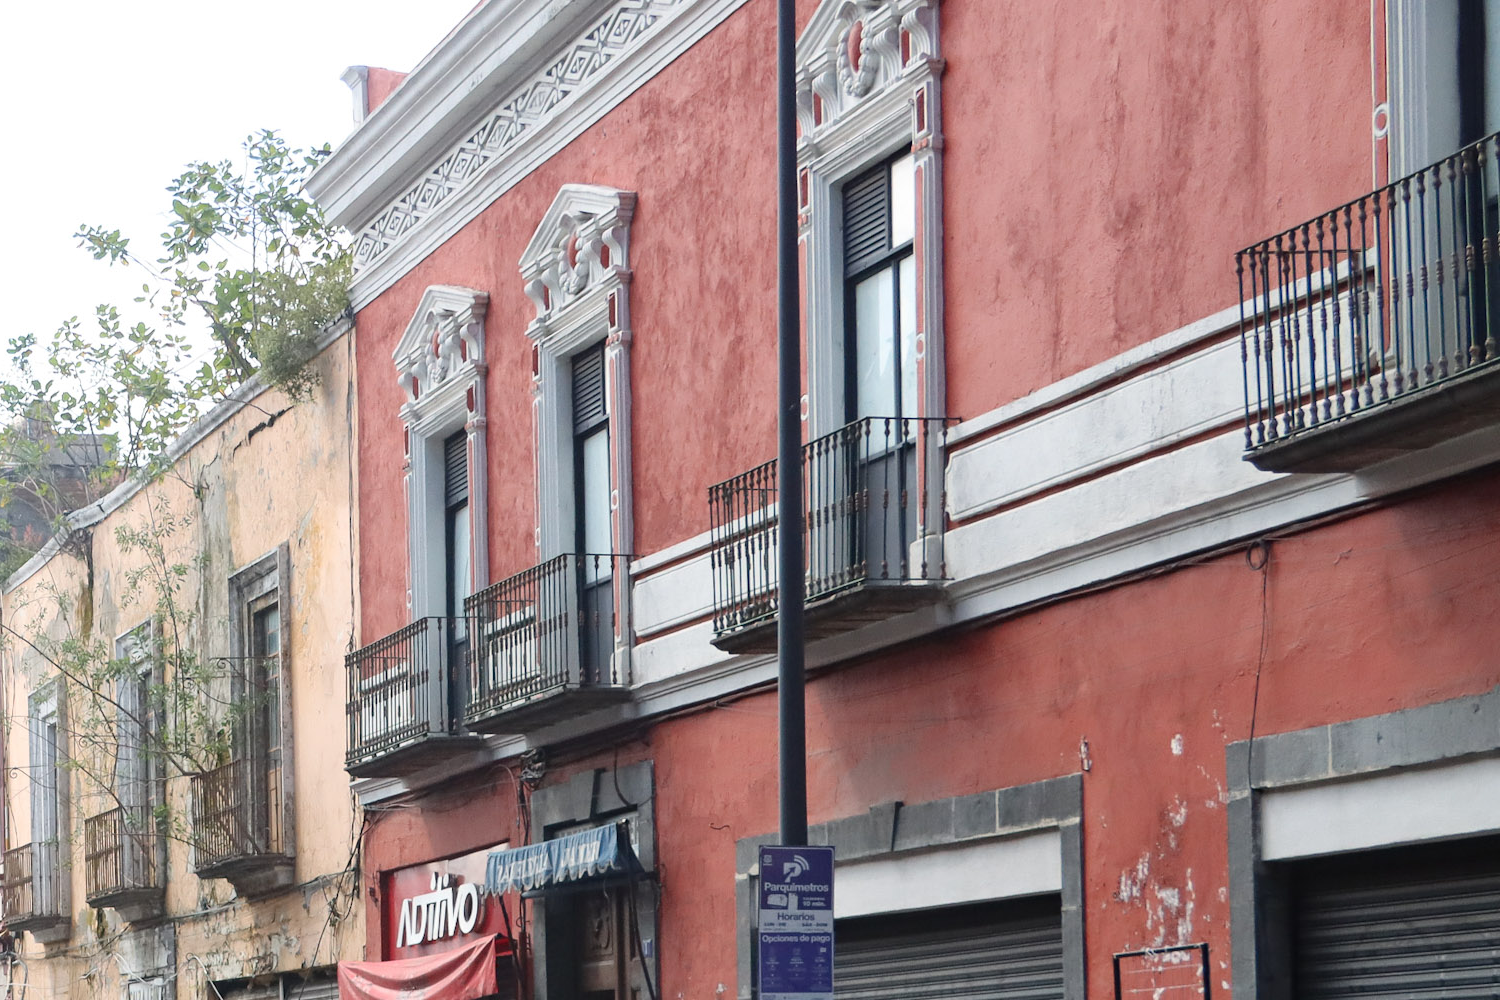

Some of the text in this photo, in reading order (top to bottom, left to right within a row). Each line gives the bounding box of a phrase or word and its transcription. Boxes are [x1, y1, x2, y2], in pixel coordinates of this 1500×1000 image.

[777, 912, 815, 921] Horarios
[800, 934, 810, 942] de
[811, 935, 831, 943] pago
